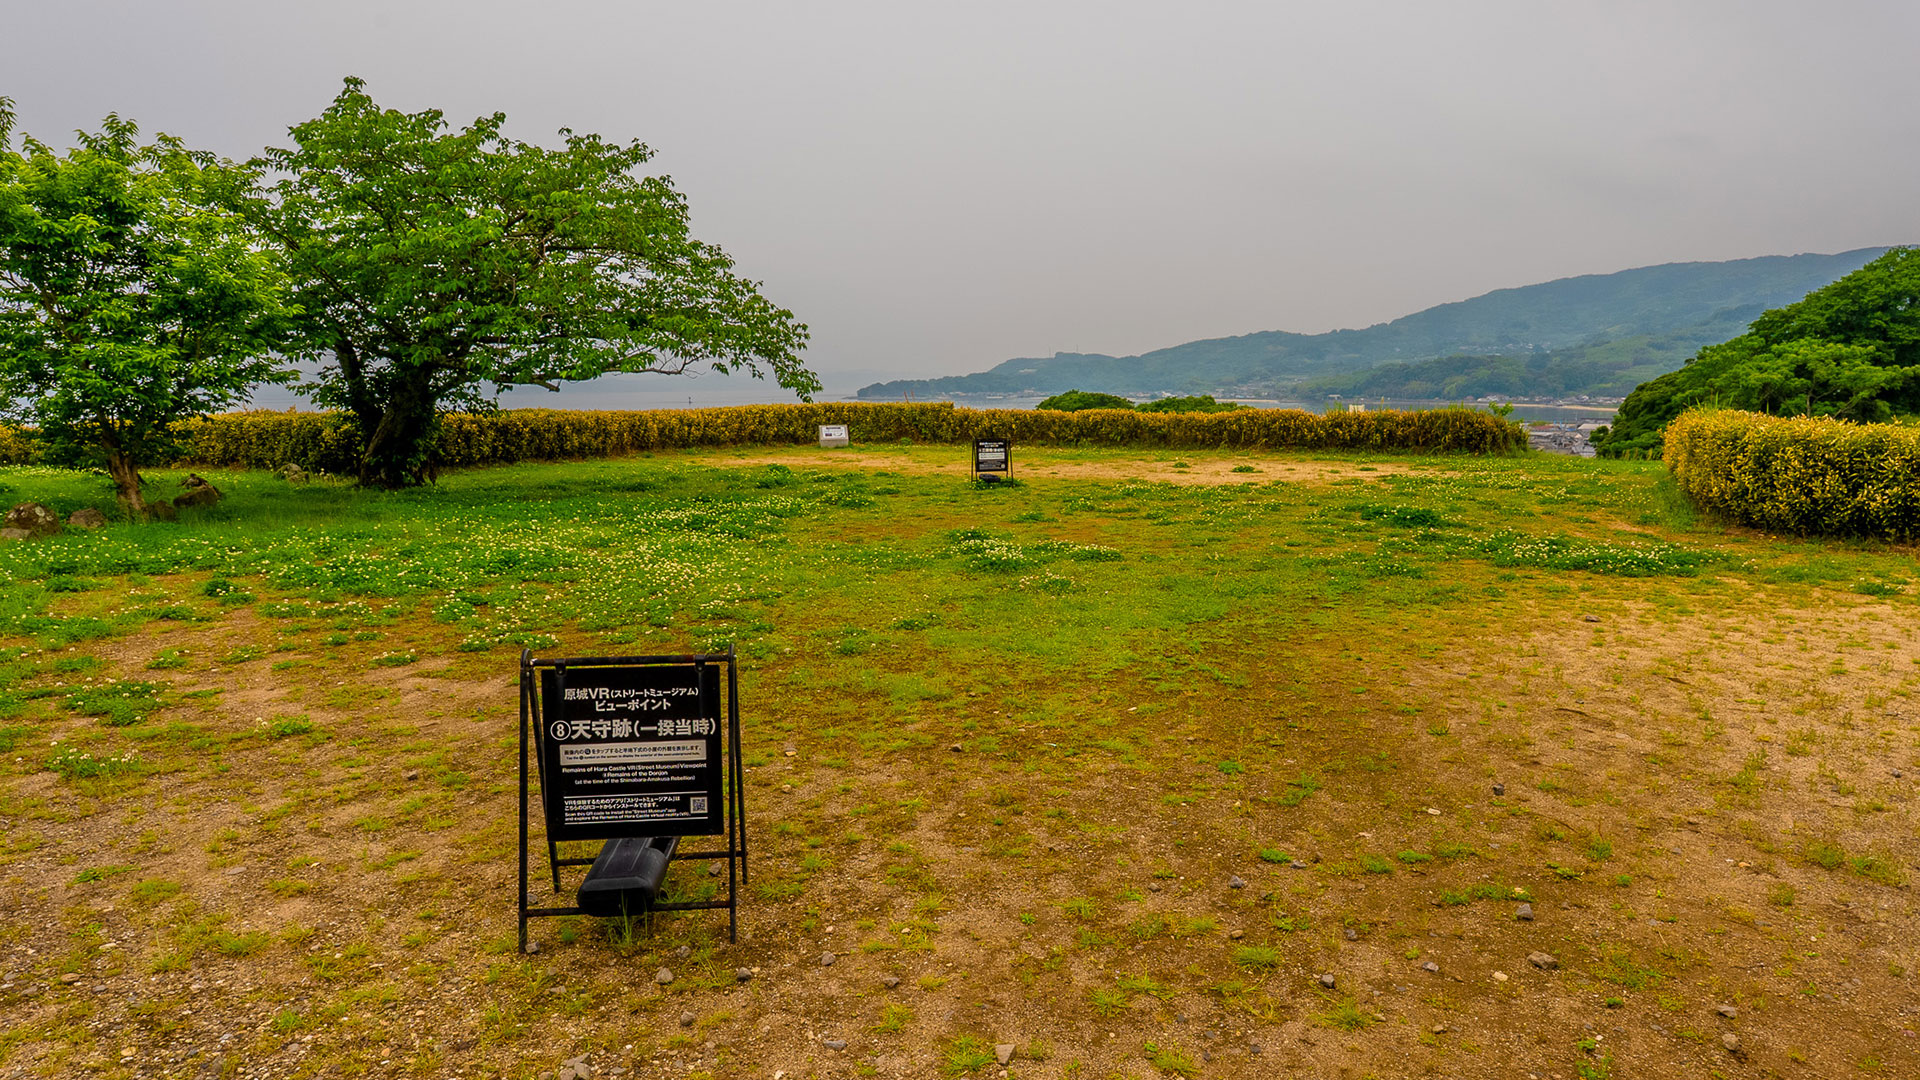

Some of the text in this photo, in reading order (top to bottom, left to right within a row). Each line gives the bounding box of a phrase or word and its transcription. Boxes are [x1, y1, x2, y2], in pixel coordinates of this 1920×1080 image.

[564, 688, 698, 700] 原城VR(ストリートミュージアム)
[596, 699, 671, 711] ビューポイント
